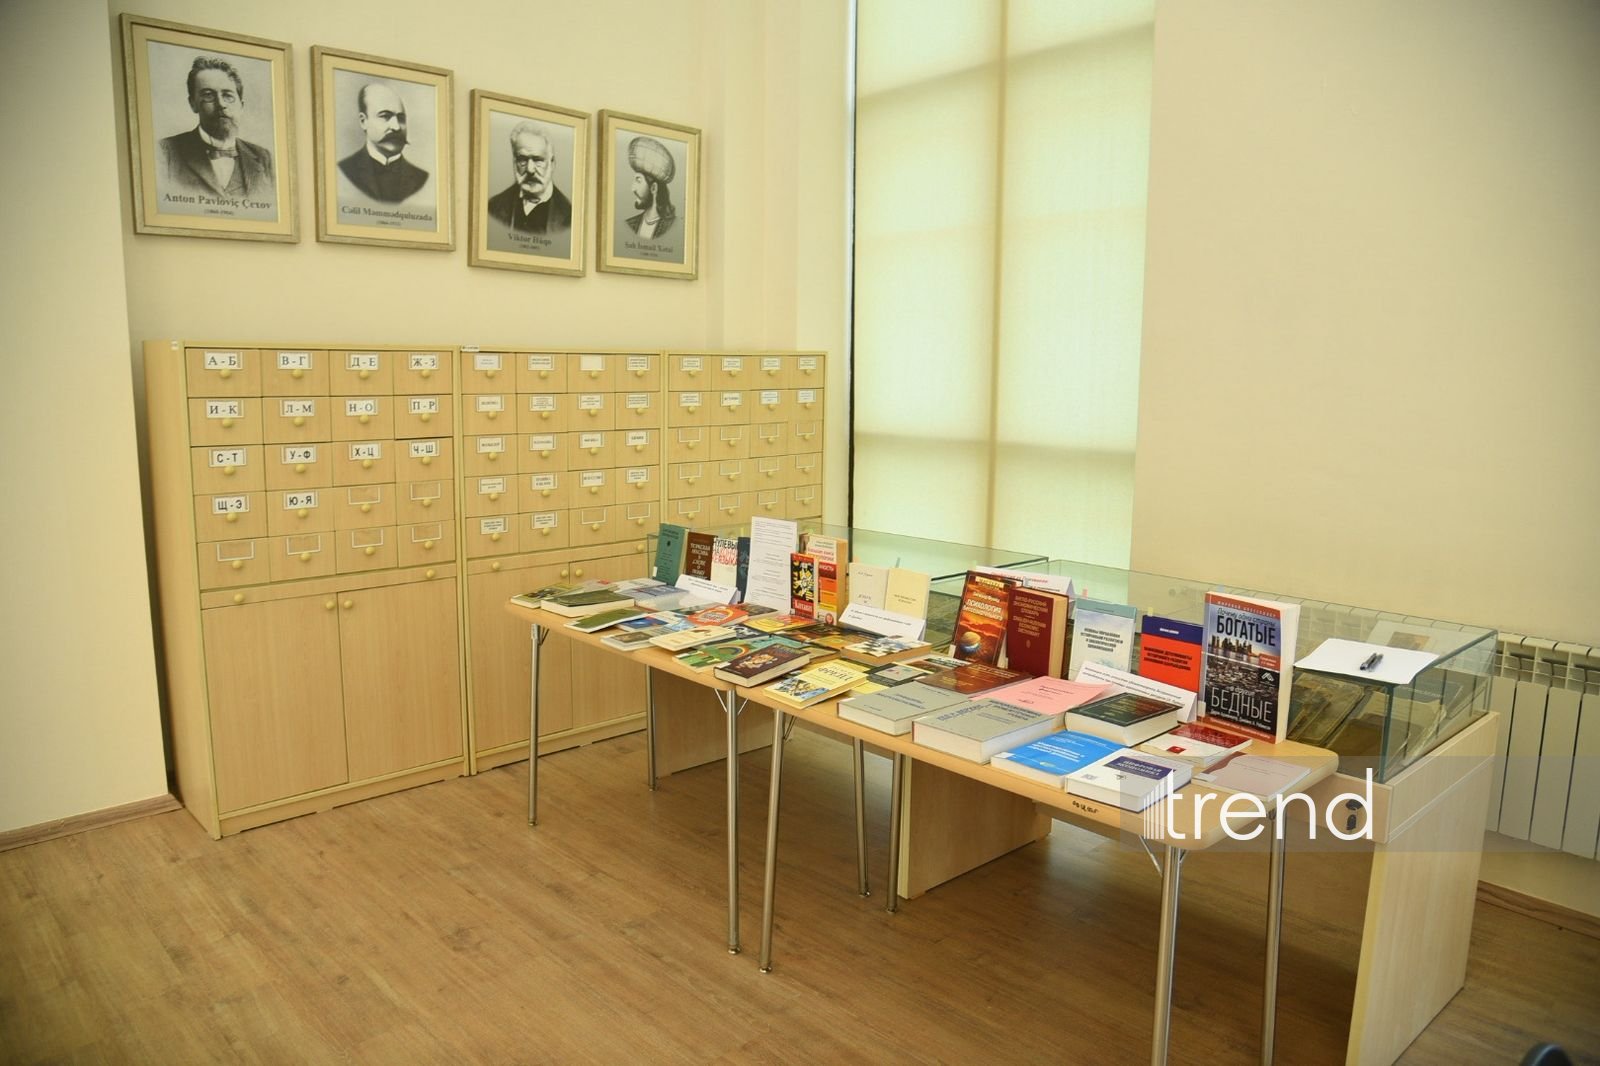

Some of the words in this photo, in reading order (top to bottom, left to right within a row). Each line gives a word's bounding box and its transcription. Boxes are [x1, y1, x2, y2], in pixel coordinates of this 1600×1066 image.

[163, 193, 196, 204] Anton
[1216, 615, 1276, 647] БОГАТЫЕ
[1211, 686, 1273, 723] БЕДНЫЕ
